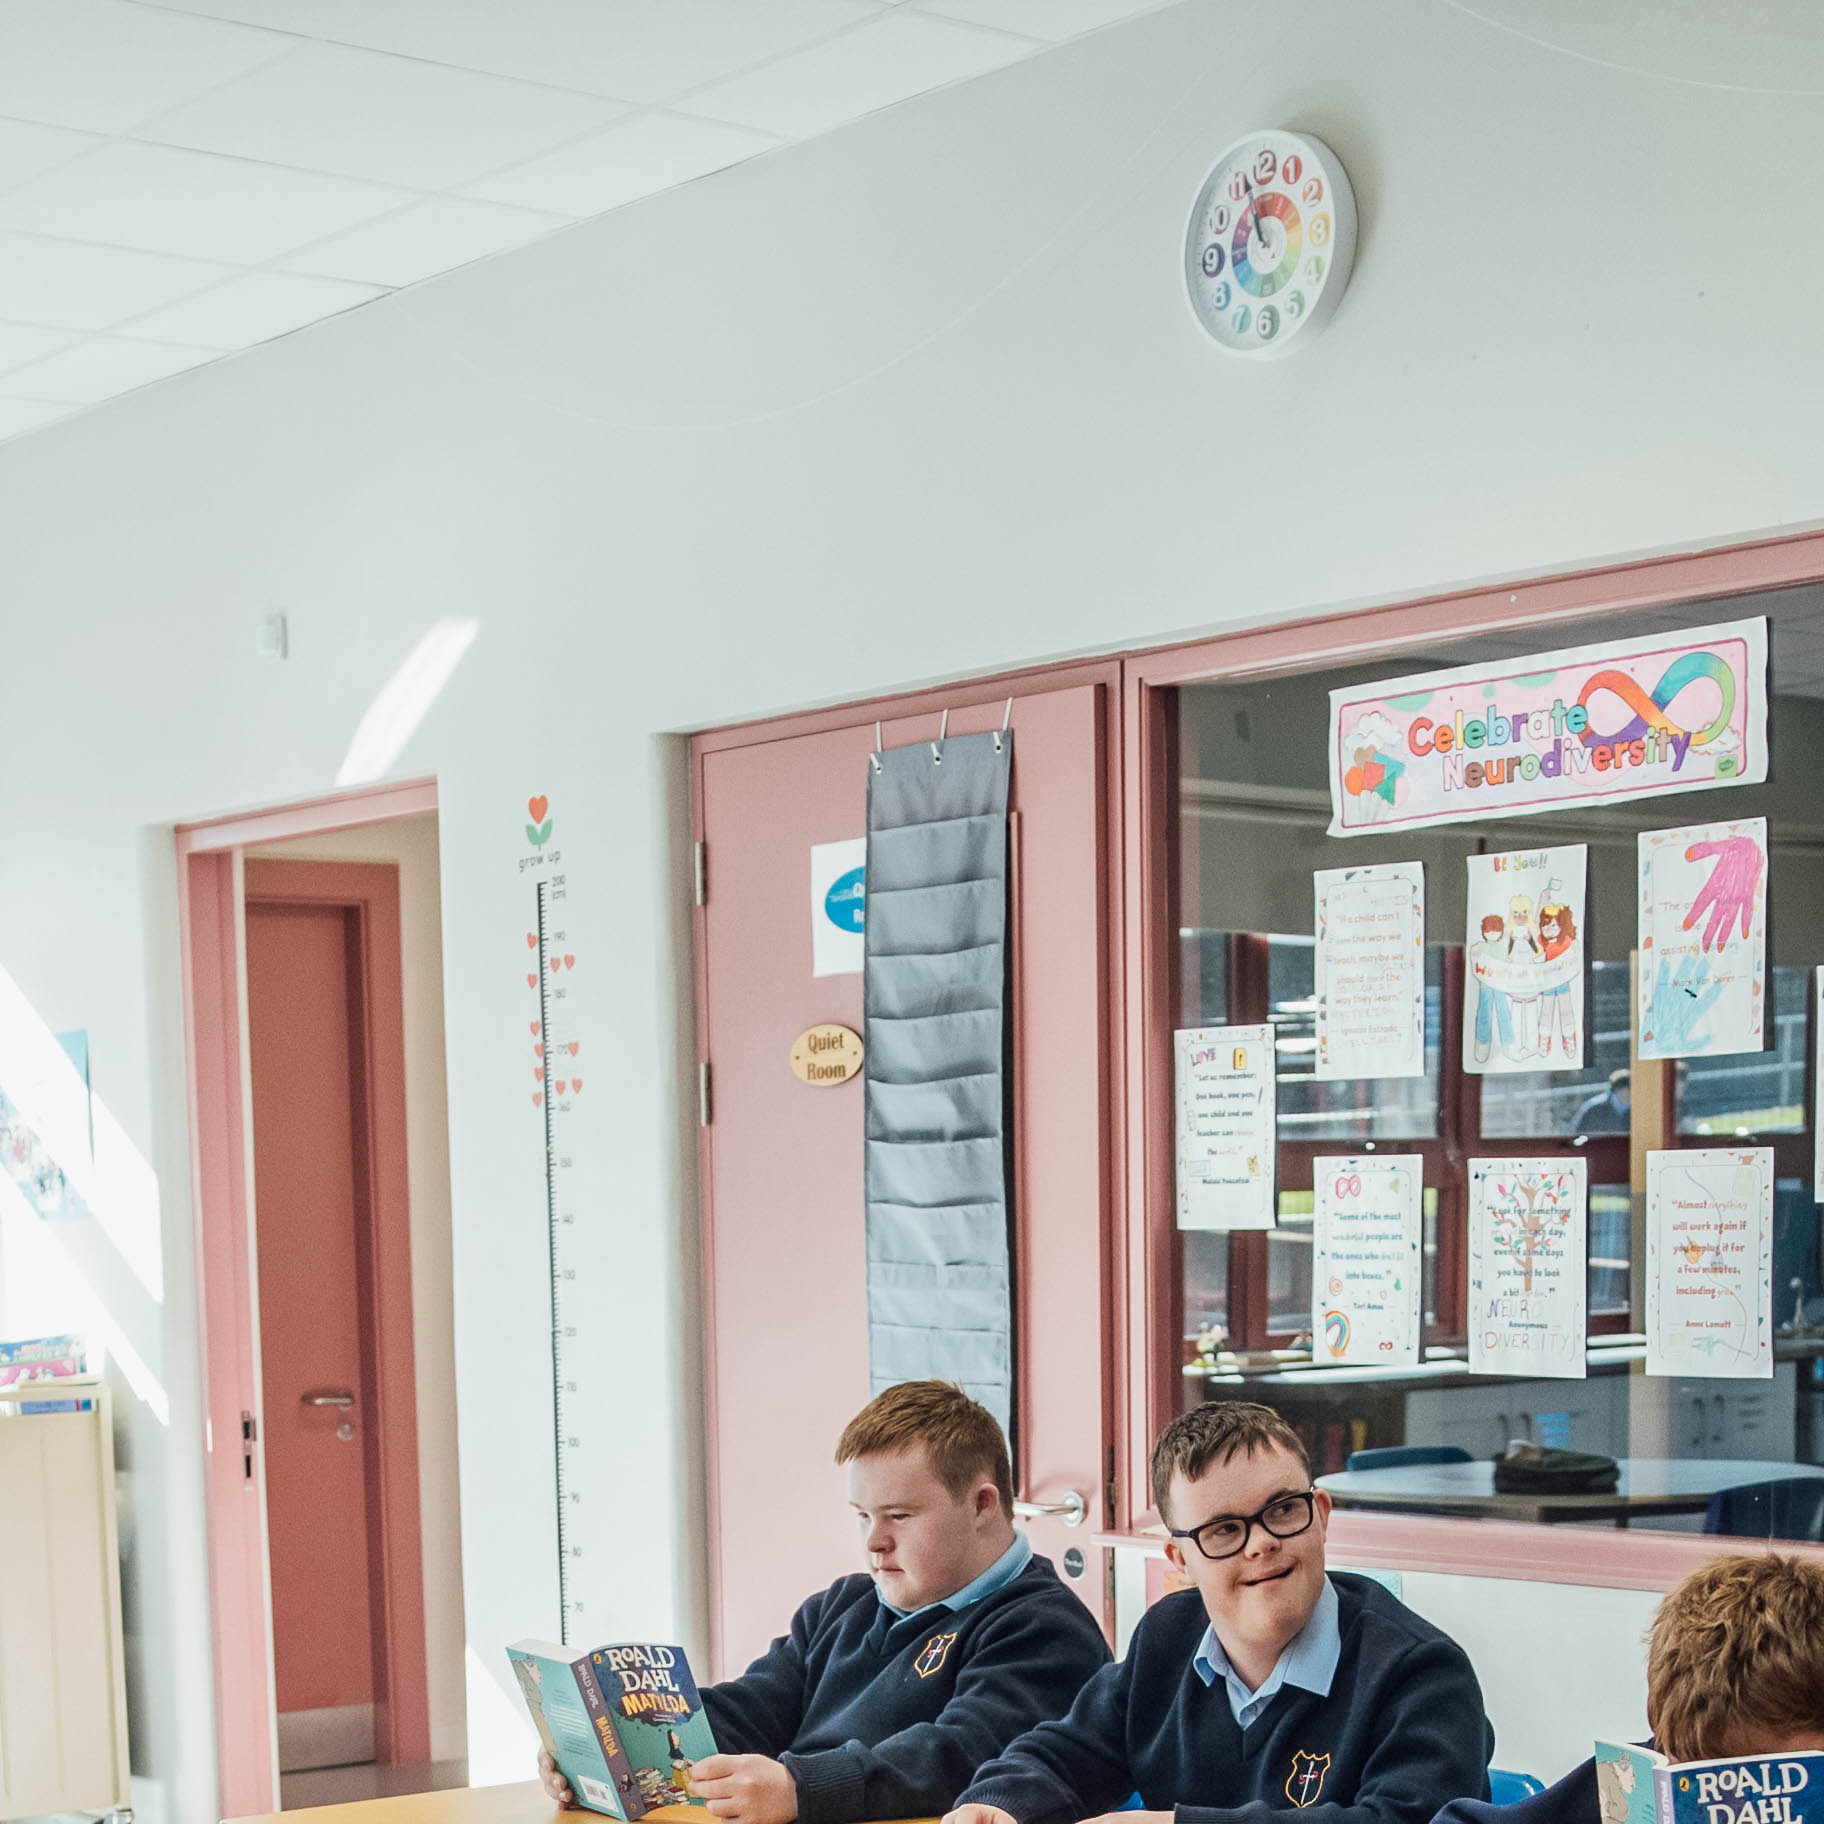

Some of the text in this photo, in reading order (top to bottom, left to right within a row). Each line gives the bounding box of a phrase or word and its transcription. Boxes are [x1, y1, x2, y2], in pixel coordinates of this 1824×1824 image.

[1408, 699, 1588, 757] Celebrate
[1442, 725, 1691, 792] Neurodiversity
[808, 1031, 845, 1054] Quiet
[807, 1062, 846, 1080] Room
[1713, 1220, 1738, 1235] again
[1730, 1242, 1745, 1252] for
[1544, 1267, 1560, 1277] look
[1676, 1285, 1716, 1300] including
[605, 1646, 676, 1672] ROALD
[619, 1669, 681, 1692] DAHL
[621, 1693, 692, 1716] MATILDA
[595, 1715, 619, 1758] MATILDA
[1695, 1762, 1809, 1804] ROALD
